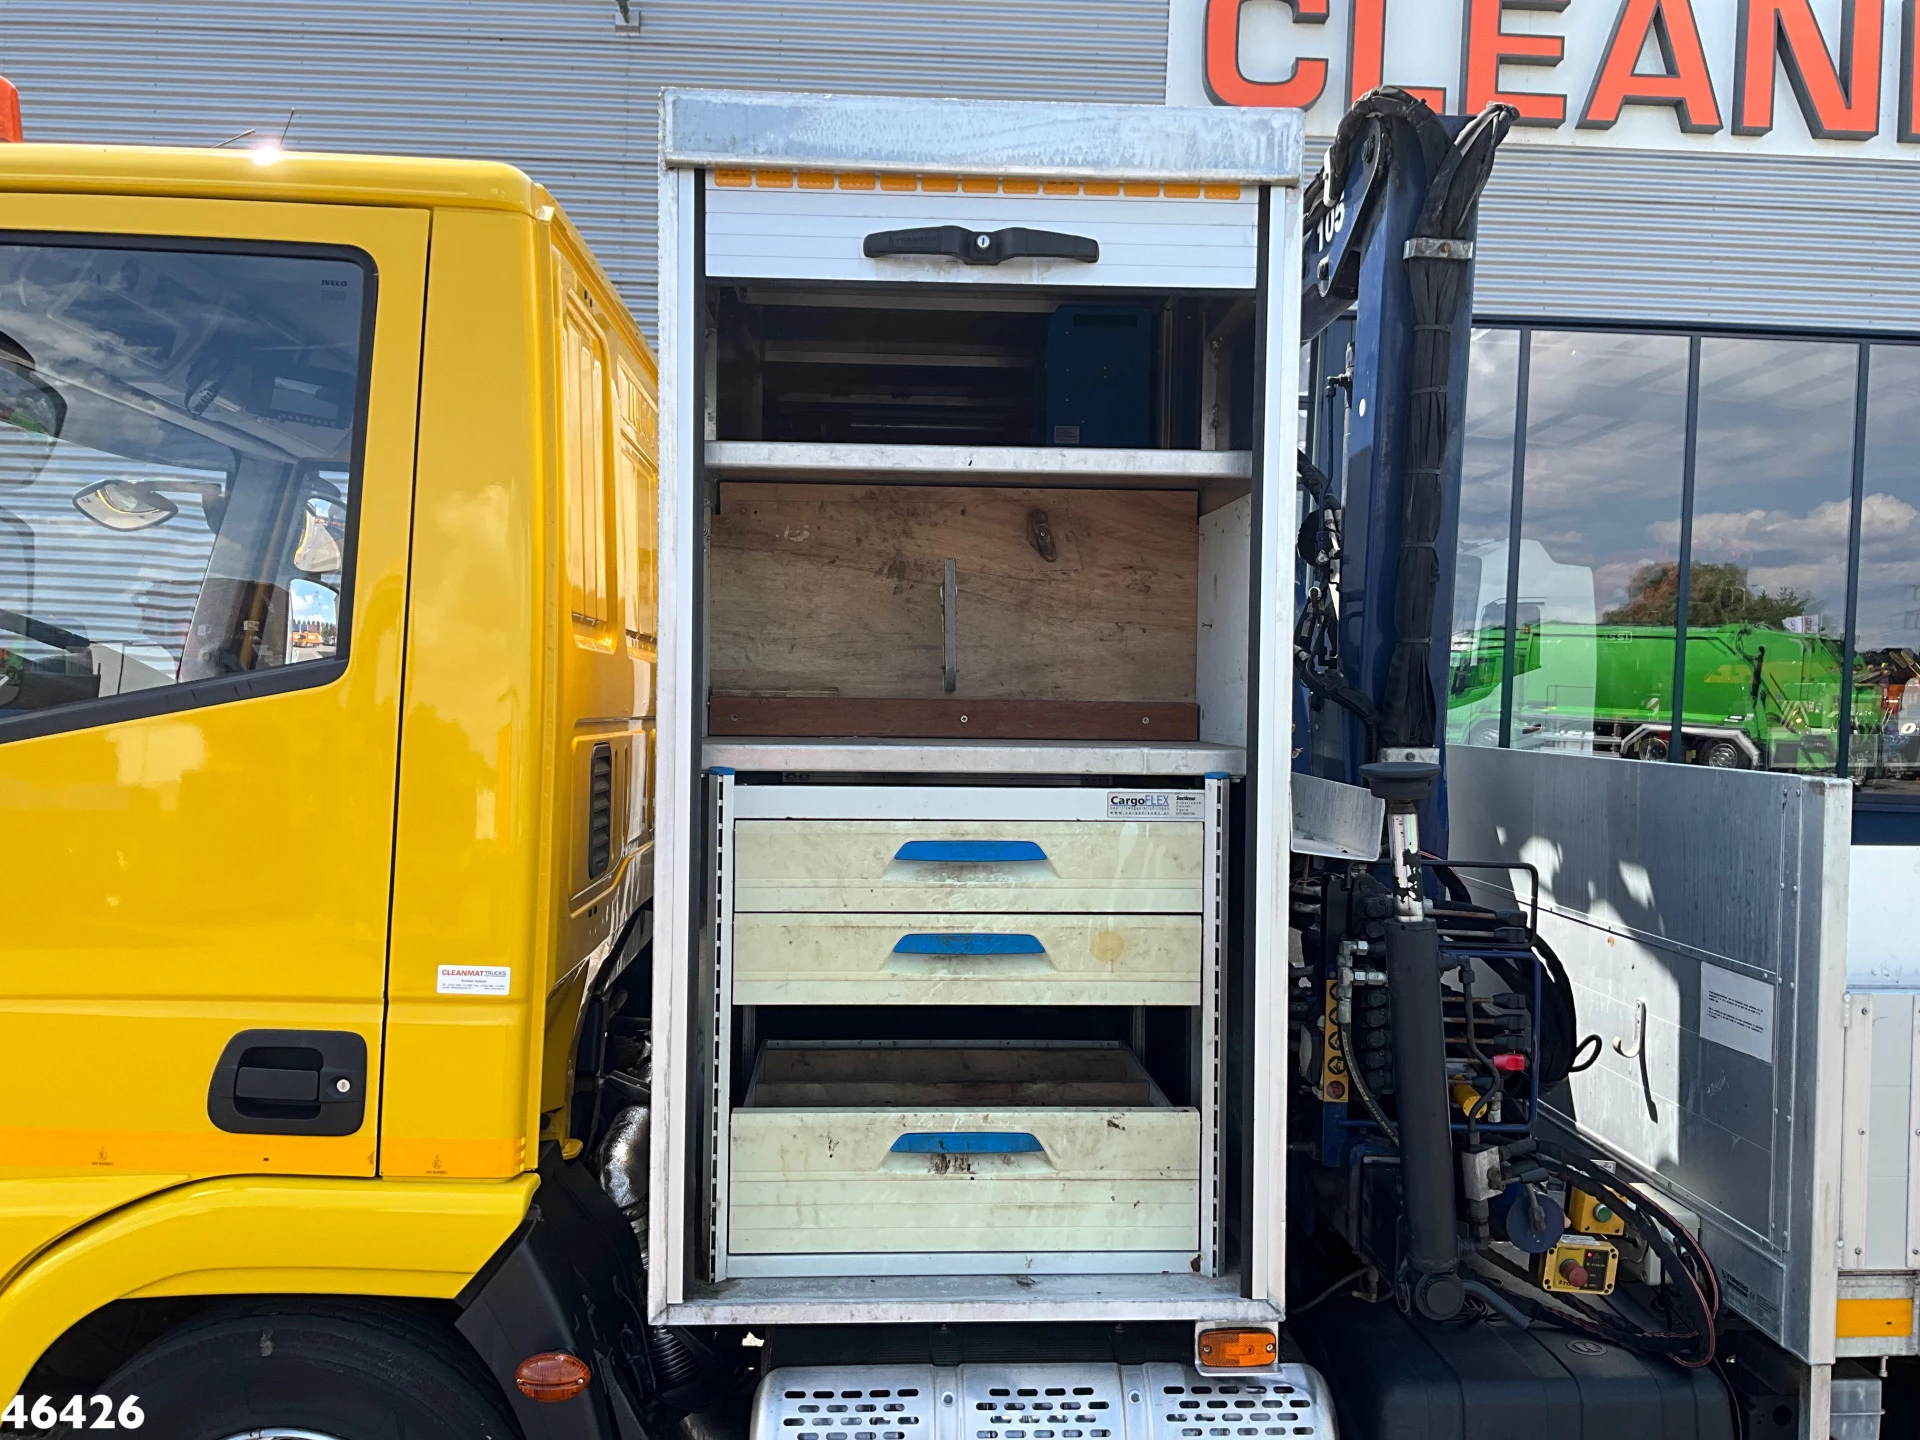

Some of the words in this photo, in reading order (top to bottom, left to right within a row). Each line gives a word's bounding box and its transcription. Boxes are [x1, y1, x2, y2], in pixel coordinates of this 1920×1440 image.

[1201, 0, 1920, 143] CLEAN
[1110, 795, 1169, 806] CargoFLEX
[441, 969, 484, 977] CLEANMAT
